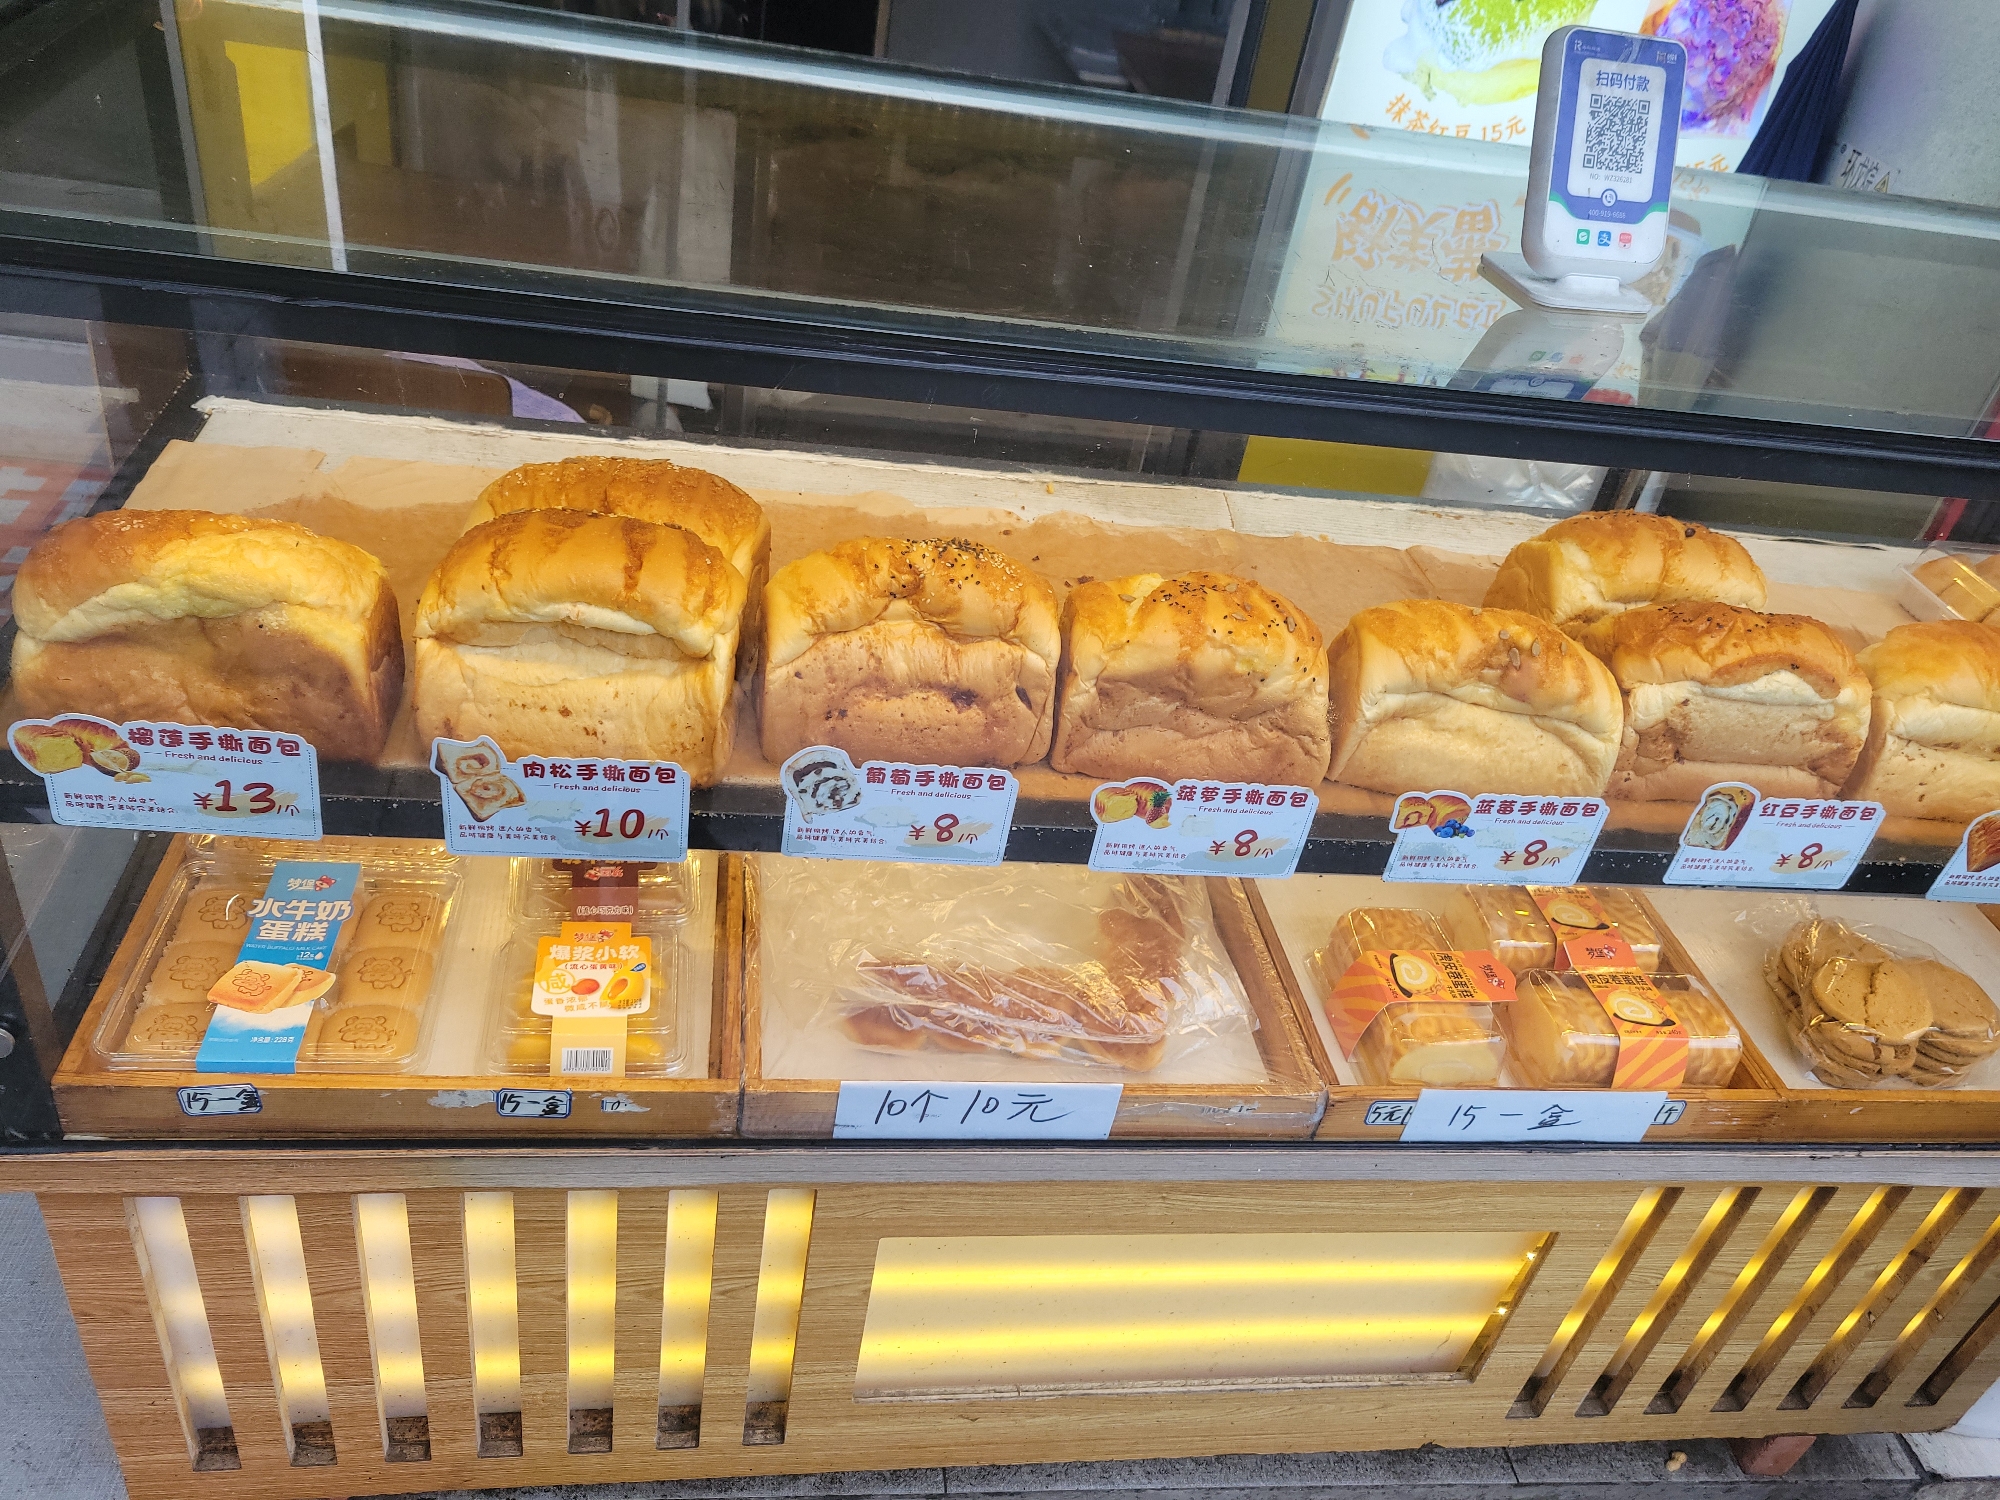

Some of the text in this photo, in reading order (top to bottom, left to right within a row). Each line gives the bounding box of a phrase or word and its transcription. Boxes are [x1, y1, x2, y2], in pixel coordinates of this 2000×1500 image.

[1596, 70, 1650, 92] 扫码付款
[1481, 115, 1527, 143] 15元
[128, 726, 302, 757] 榴莲手撕面包
[164, 750, 263, 765] Fresh and delicious
[522, 761, 676, 784] 肉松手撕面包
[866, 766, 1006, 791] 葡萄手撕面包
[553, 782, 580, 790] Fresh
[601, 784, 642, 793] delicious
[890, 788, 916, 796] Fresh
[934, 791, 972, 800] delicious
[1176, 784, 1309, 808] 菠萝手撕面包
[1198, 806, 1222, 814] Fresh
[1239, 808, 1274, 816] delicious
[1474, 799, 1600, 817] 蓝莓手撕面包
[1758, 802, 1877, 821] 红豆手撕面包
[248, 898, 353, 922] 水牛奶
[256, 920, 329, 942] 蛋糕
[549, 944, 640, 961] 爆浆小软
